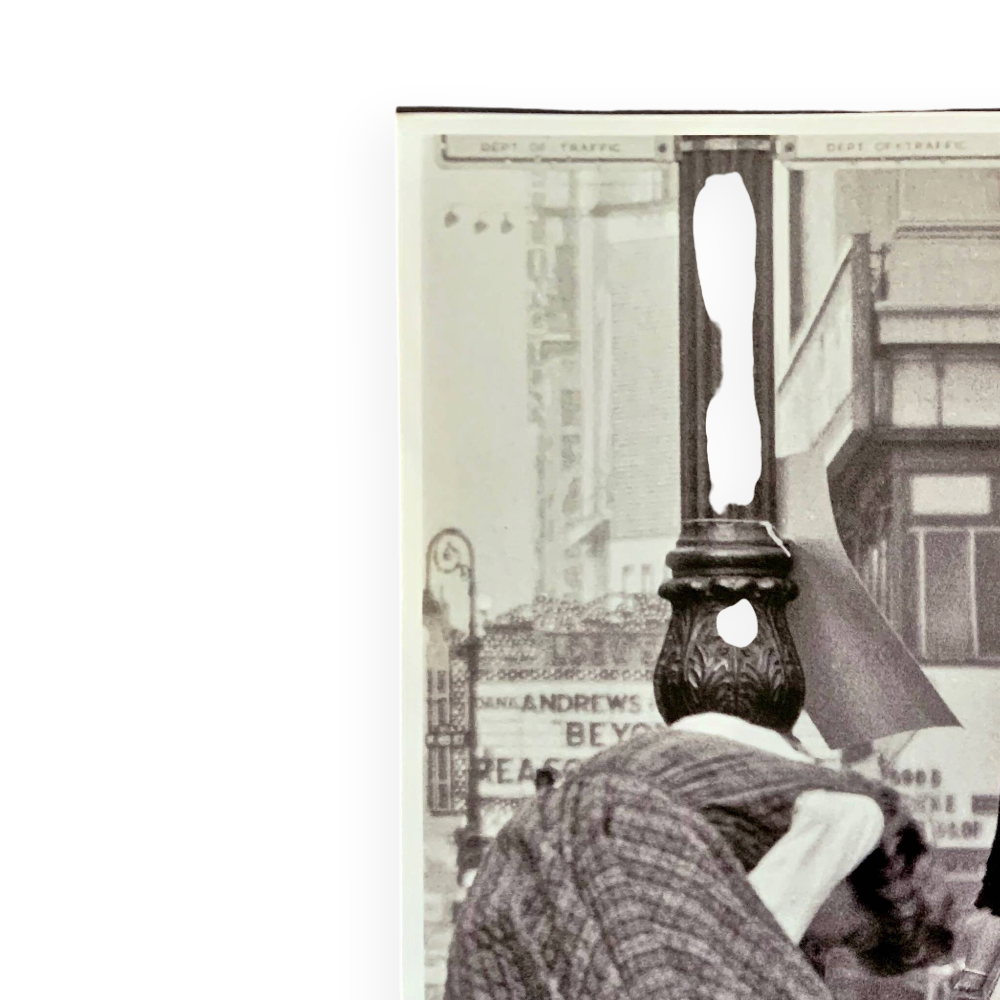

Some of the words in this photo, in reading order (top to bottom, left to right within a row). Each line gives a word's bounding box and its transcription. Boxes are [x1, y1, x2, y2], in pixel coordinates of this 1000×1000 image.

[480, 142, 518, 152] DEPT
[528, 142, 546, 152] OF
[561, 142, 620, 153] TRAFFIC
[826, 142, 863, 152] DEPT
[905, 141, 968, 152] TRAFFIC
[521, 694, 642, 713] ANDREWS
